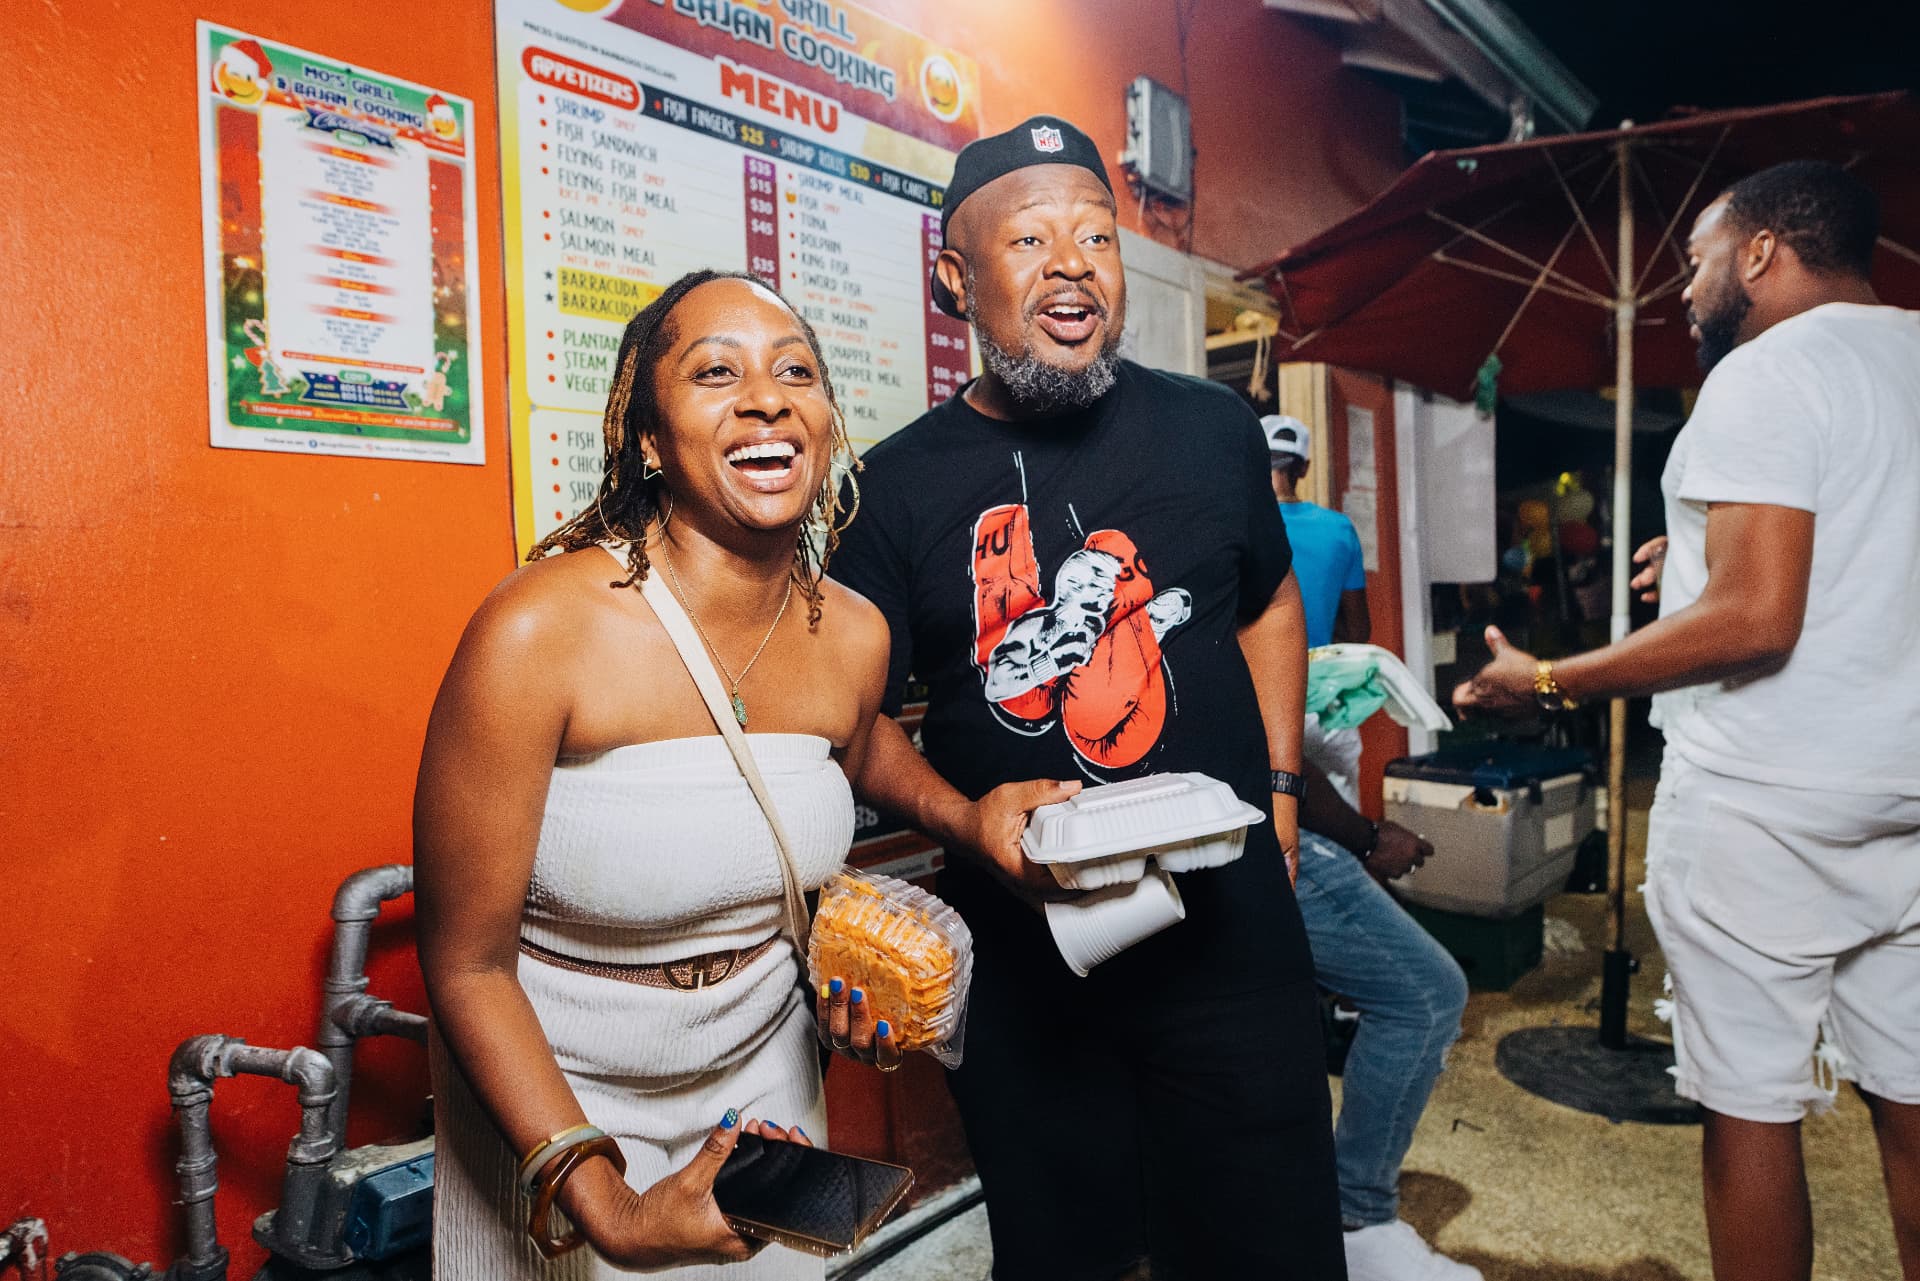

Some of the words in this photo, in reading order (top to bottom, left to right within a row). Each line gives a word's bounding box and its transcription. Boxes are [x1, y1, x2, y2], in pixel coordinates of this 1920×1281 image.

[783, 0, 854, 40] GRILL
[783, 27, 895, 98] COOKING
[352, 80, 395, 101] GRILL
[531, 55, 634, 103] APPETIZERS
[294, 81, 347, 106] BAJAN
[354, 98, 423, 128] COOKING
[554, 97, 606, 123] SHRIMP
[720, 62, 838, 133] MENU
[663, 97, 688, 122] FISH
[691, 106, 736, 140] FINGERS
[741, 125, 765, 146] $25
[779, 137, 815, 163] SHRIMP
[1040, 136, 1061, 148] NFL
[557, 119, 584, 142] FISH
[592, 130, 658, 162] SANDWICH
[750, 177, 773, 195] $15
[558, 143, 603, 171] FLYING
[611, 158, 637, 180] FISH
[750, 198, 774, 215] $30
[558, 167, 604, 194] FLYING
[612, 181, 637, 203] FISH
[644, 191, 678, 213] MEAL
[751, 218, 774, 236] $45
[560, 208, 615, 235] SALMON
[752, 256, 775, 274] $35
[560, 232, 616, 257] SALMON
[624, 246, 657, 266] MEAL
[801, 232, 842, 253] DOLPHIN
[802, 252, 825, 269] KING
[562, 270, 639, 299] BARRACUDA
[802, 271, 836, 290] SWORD
[564, 351, 607, 372] STEAM
[877, 370, 902, 389] MEAL
[853, 404, 879, 421] MEAL
[568, 430, 595, 451] FISH
